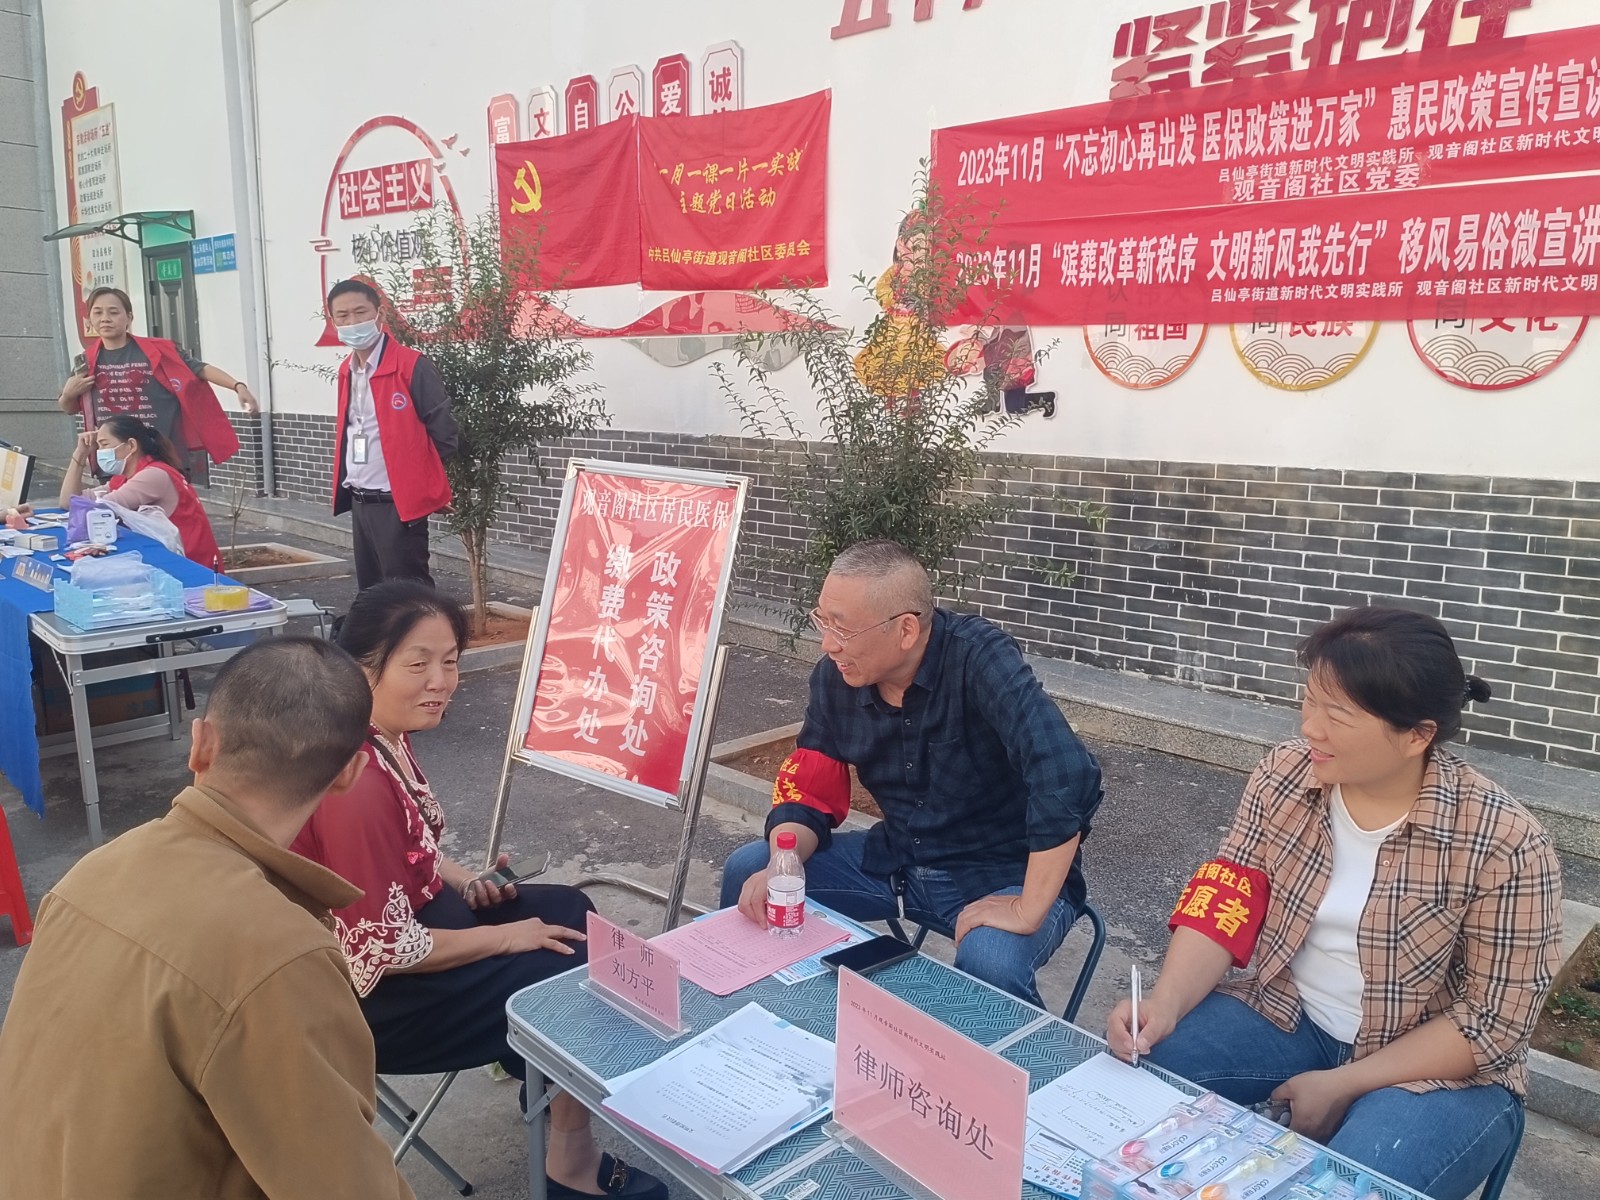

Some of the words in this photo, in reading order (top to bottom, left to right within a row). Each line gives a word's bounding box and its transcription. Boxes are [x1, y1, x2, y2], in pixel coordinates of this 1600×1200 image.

[661, 80, 682, 115] 爱
[709, 66, 733, 113] 诚
[575, 99, 589, 132] 自
[957, 137, 1045, 187] 2023年11月
[1232, 163, 1421, 202] 观音阁社区党委
[340, 162, 431, 216] 社会主义
[680, 187, 777, 215] 主题党日活动
[351, 229, 426, 263] 核心价值观
[648, 239, 811, 266] 中共吕仙亭街道观音阁社区委员会
[1398, 204, 1600, 275] 移风易俗微宣讲
[1211, 281, 1403, 303] 吕仙亭街道新时代文明实践所
[1416, 274, 1598, 297] 观音阁社区新时代文明
[580, 489, 730, 532] 观音阁社区居民医保
[573, 543, 634, 745] 缴费代办处
[619, 551, 681, 757] 政策咨询处
[612, 958, 655, 997] 刘方平
[853, 1043, 994, 1161] 律师咨询处
